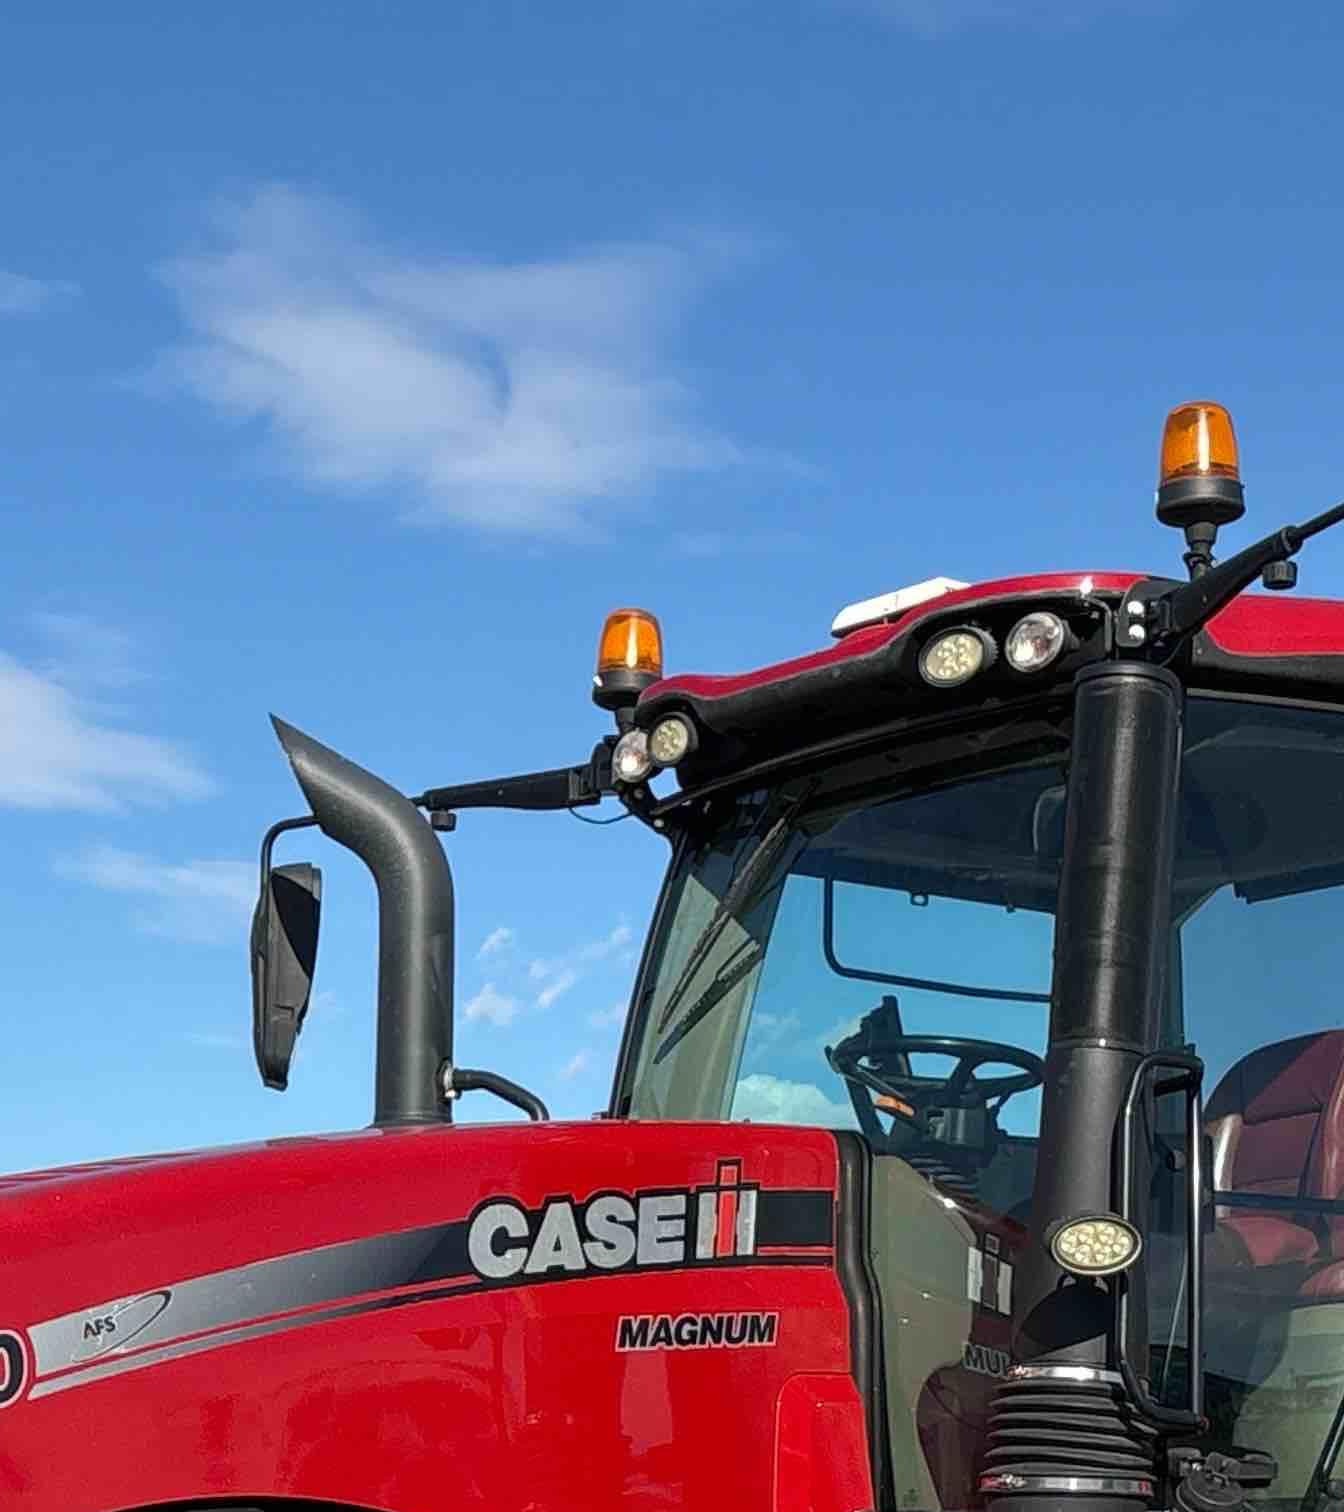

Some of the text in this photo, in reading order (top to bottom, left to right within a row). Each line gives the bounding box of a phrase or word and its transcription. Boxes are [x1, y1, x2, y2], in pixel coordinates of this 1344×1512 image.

[468, 1195, 686, 1278] CASE
[83, 1315, 116, 1339] AFS
[616, 1312, 778, 1351] MAGNUM
